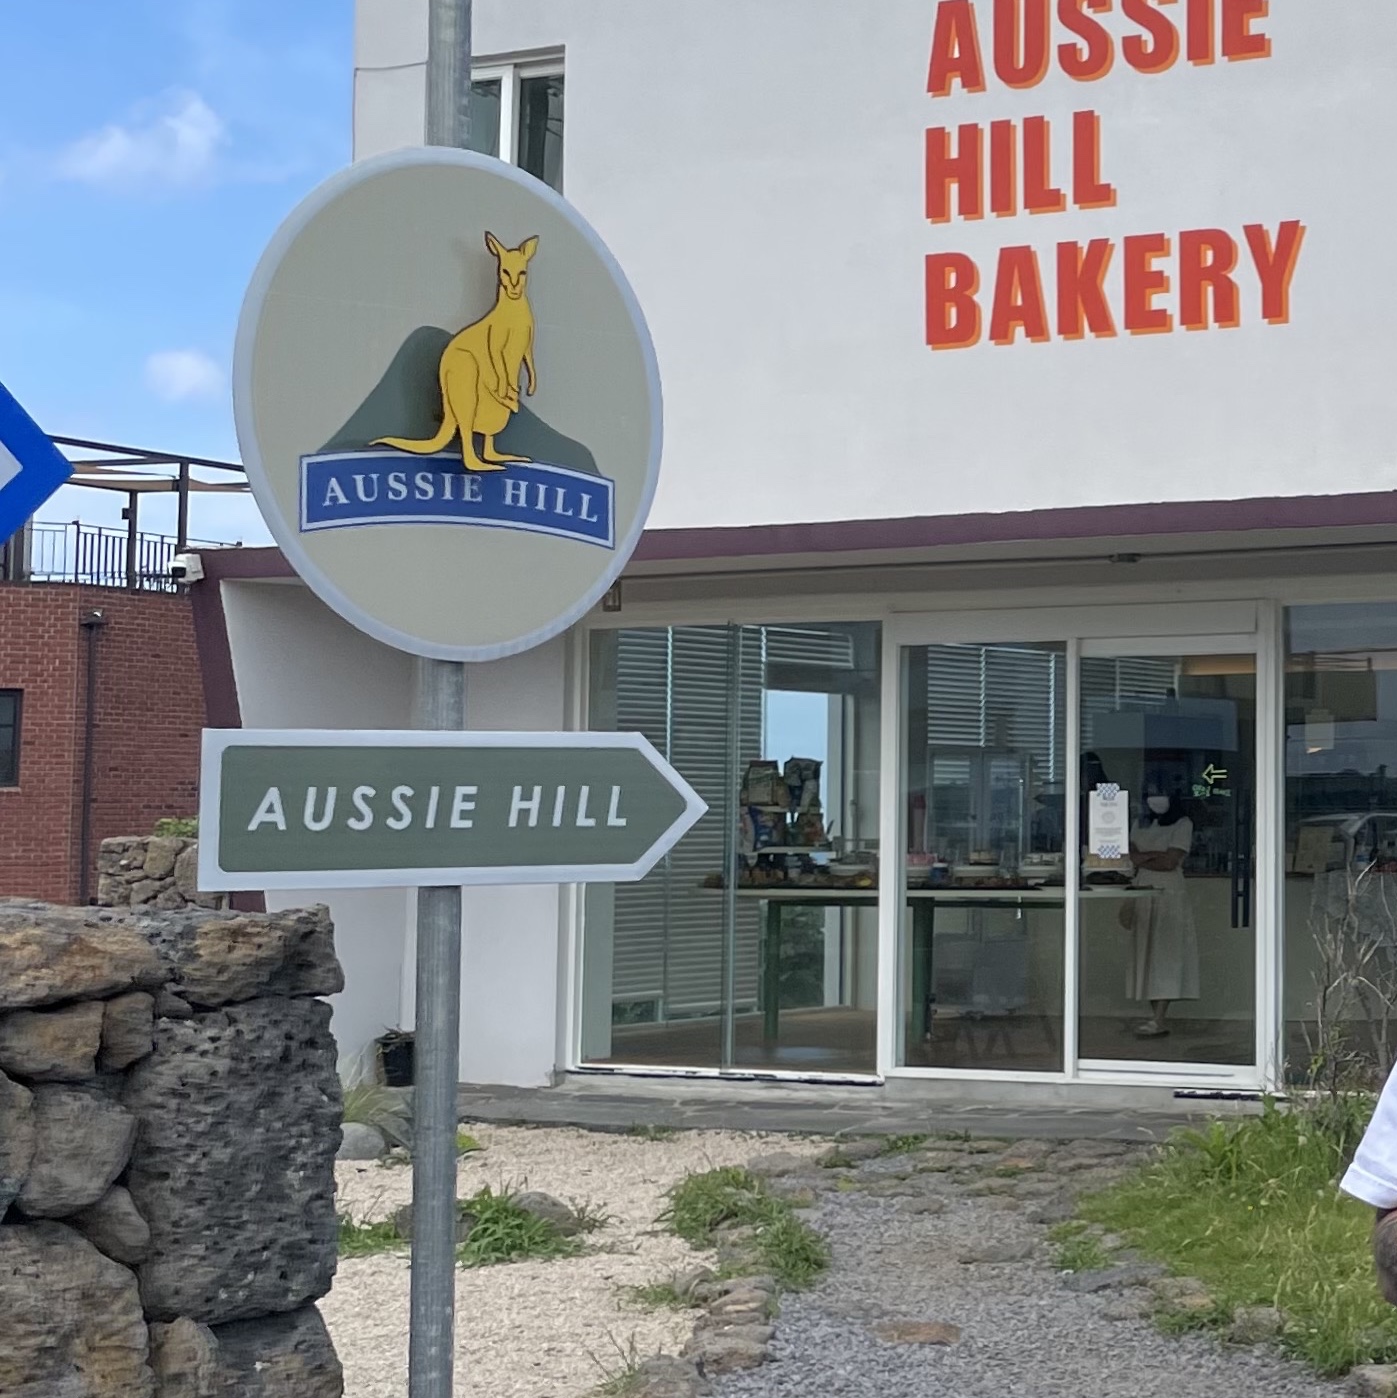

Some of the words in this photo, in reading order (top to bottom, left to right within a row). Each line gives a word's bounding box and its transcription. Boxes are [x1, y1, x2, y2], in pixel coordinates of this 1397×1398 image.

[926, 0, 1272, 97] AUSSIE
[925, 110, 1116, 224] HILL
[925, 220, 1306, 350] BAKERY
[322, 472, 483, 507] AUSSIE
[503, 478, 599, 523] HILL
[247, 785, 478, 832] AUSSIE
[508, 785, 628, 828] HILL
